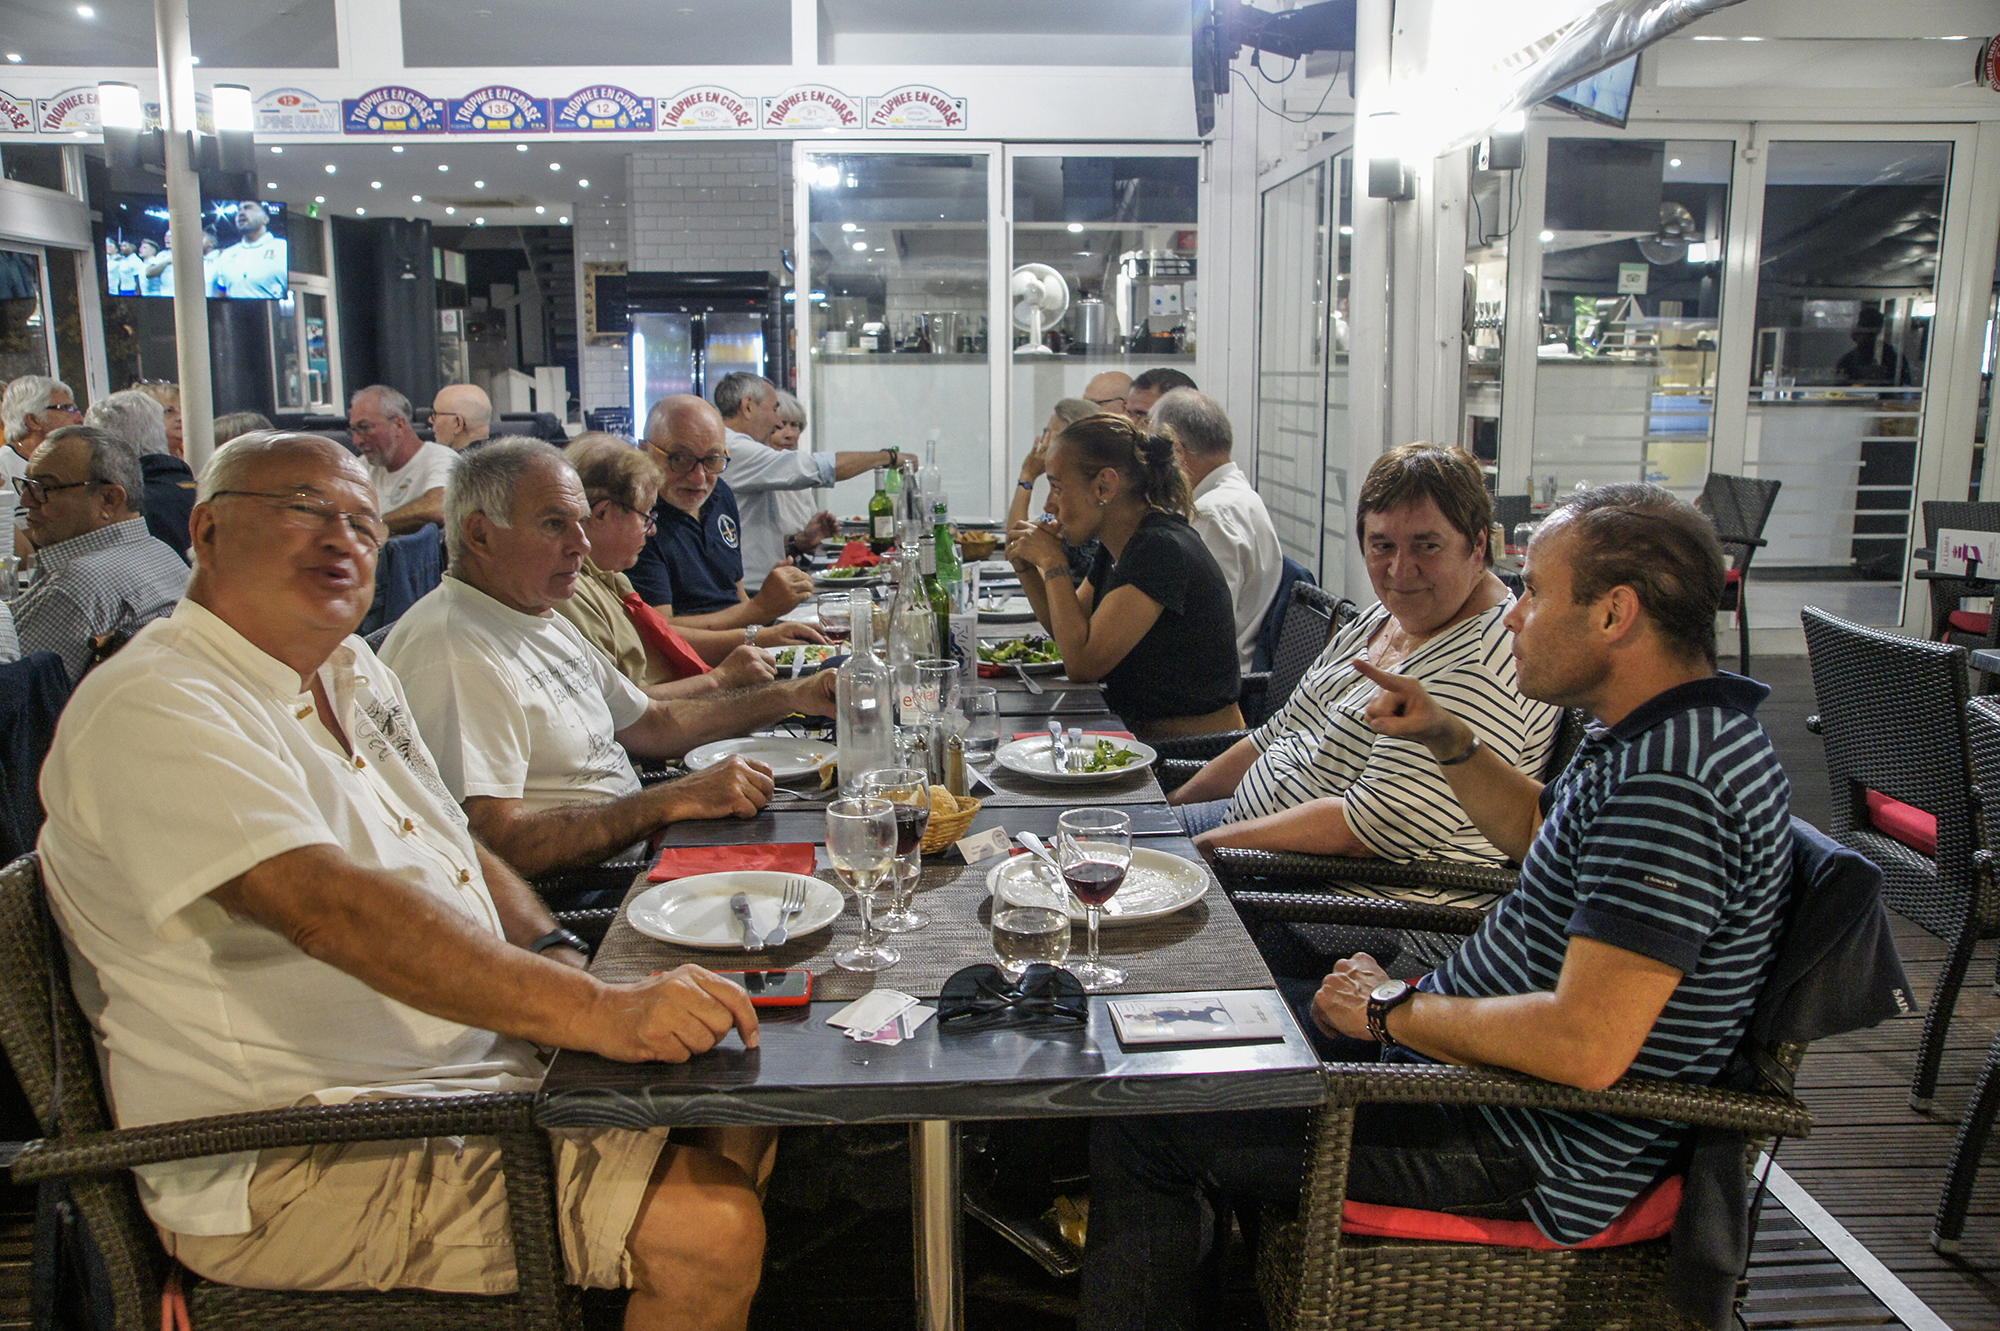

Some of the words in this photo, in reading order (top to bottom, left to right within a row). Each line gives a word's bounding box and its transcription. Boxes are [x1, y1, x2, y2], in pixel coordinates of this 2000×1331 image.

[0, 97, 30, 130] ORSE
[43, 93, 85, 130] TROPHEE
[282, 96, 294, 106] 12
[350, 89, 390, 123] TROPHEE
[390, 88, 406, 100] EN
[406, 92, 438, 124] CORSE
[384, 105, 404, 115] 130
[455, 88, 495, 122] TROPHEE
[495, 88, 511, 100] EN
[510, 92, 542, 122] CORSE
[488, 104, 509, 114] 135
[559, 88, 600, 122] TROPHEE
[600, 88, 616, 100] EN
[615, 91, 646, 122] CORSE
[596, 104, 610, 113] 12
[662, 92, 704, 128] TROPHEE
[705, 92, 720, 104] EN
[720, 95, 753, 127] CORSE
[700, 110, 716, 118] 150
[766, 91, 808, 126] TROPHEE
[810, 90, 826, 102] EN
[825, 94, 858, 126] CORSE
[870, 91, 912, 126] TROPHEE
[915, 91, 930, 103] EN
[929, 95, 962, 127] CORSE
[256, 114, 293, 129] LPINE
[294, 108, 338, 129] RALLY
[903, 690, 939, 707] evian
